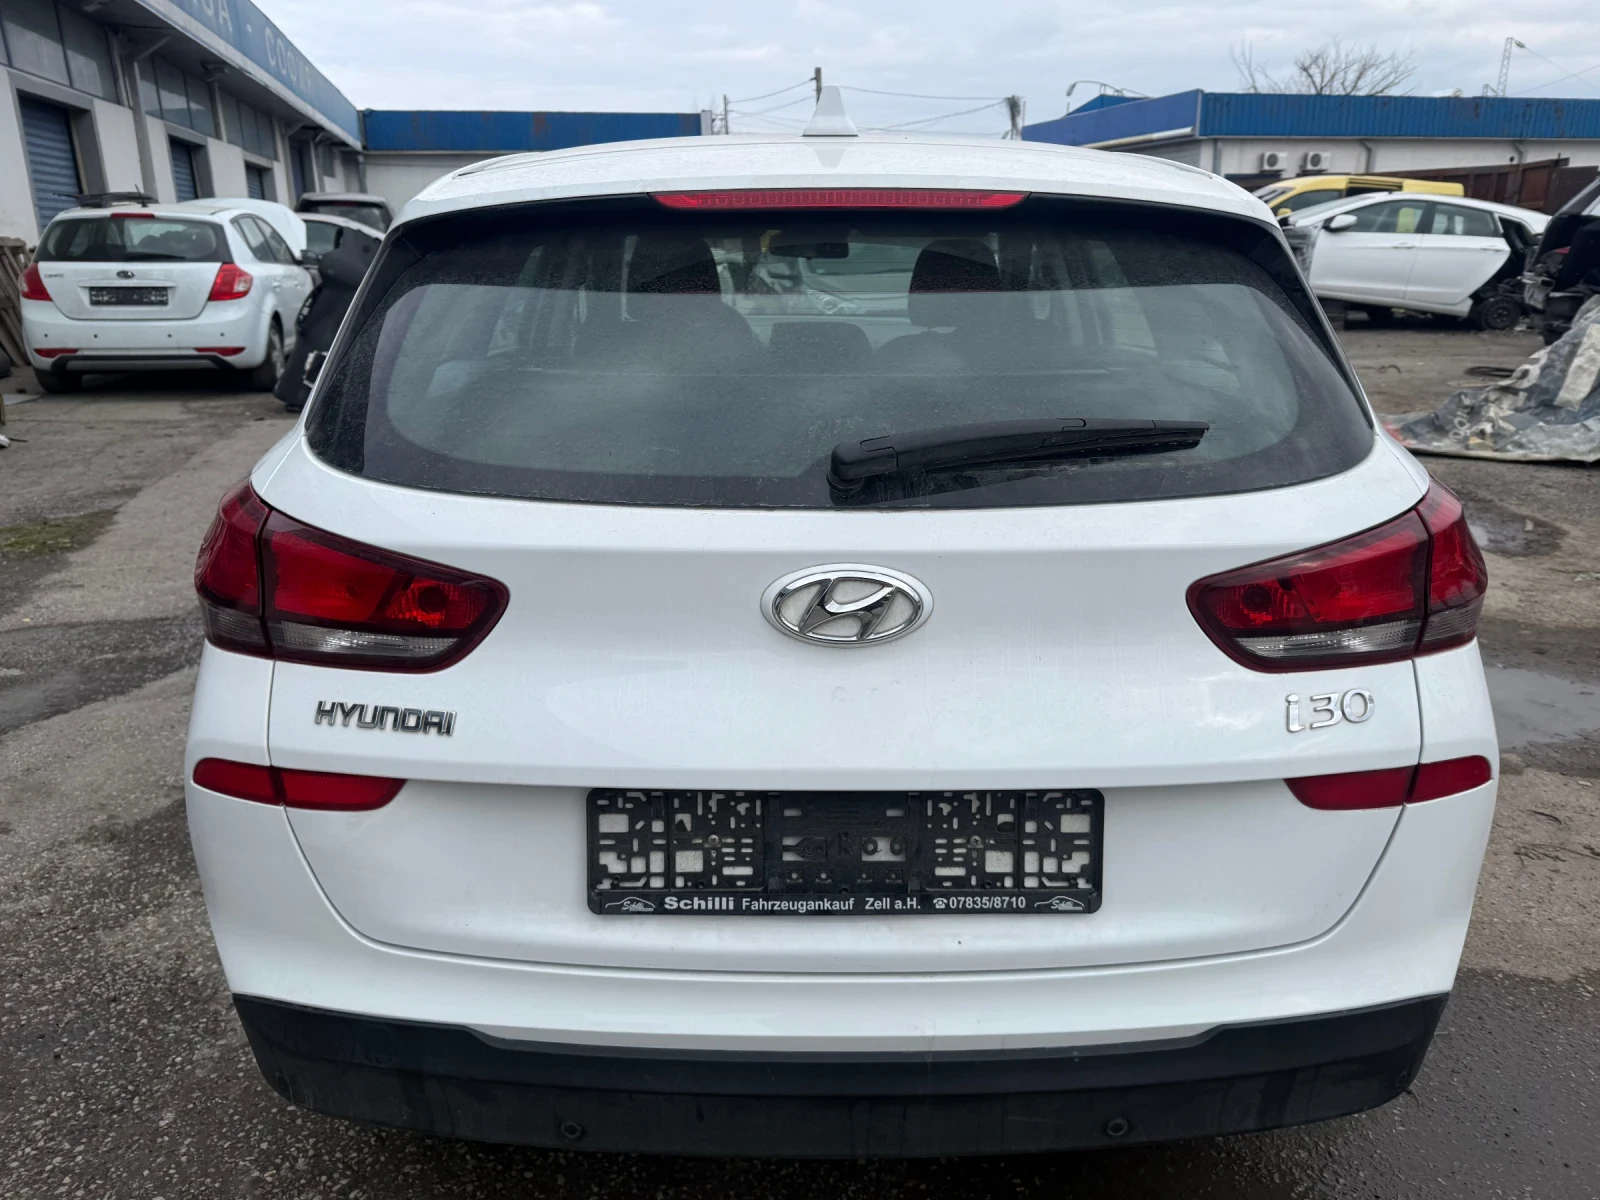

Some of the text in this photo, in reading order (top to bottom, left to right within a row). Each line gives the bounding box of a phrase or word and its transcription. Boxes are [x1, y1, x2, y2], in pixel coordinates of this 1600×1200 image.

[314, 700, 457, 736] HYUNDAI
[1285, 688, 1375, 733] i30
[663, 896, 1026, 913] Schilli Fahrzeugankauf Zell a.H. 07835/8710
